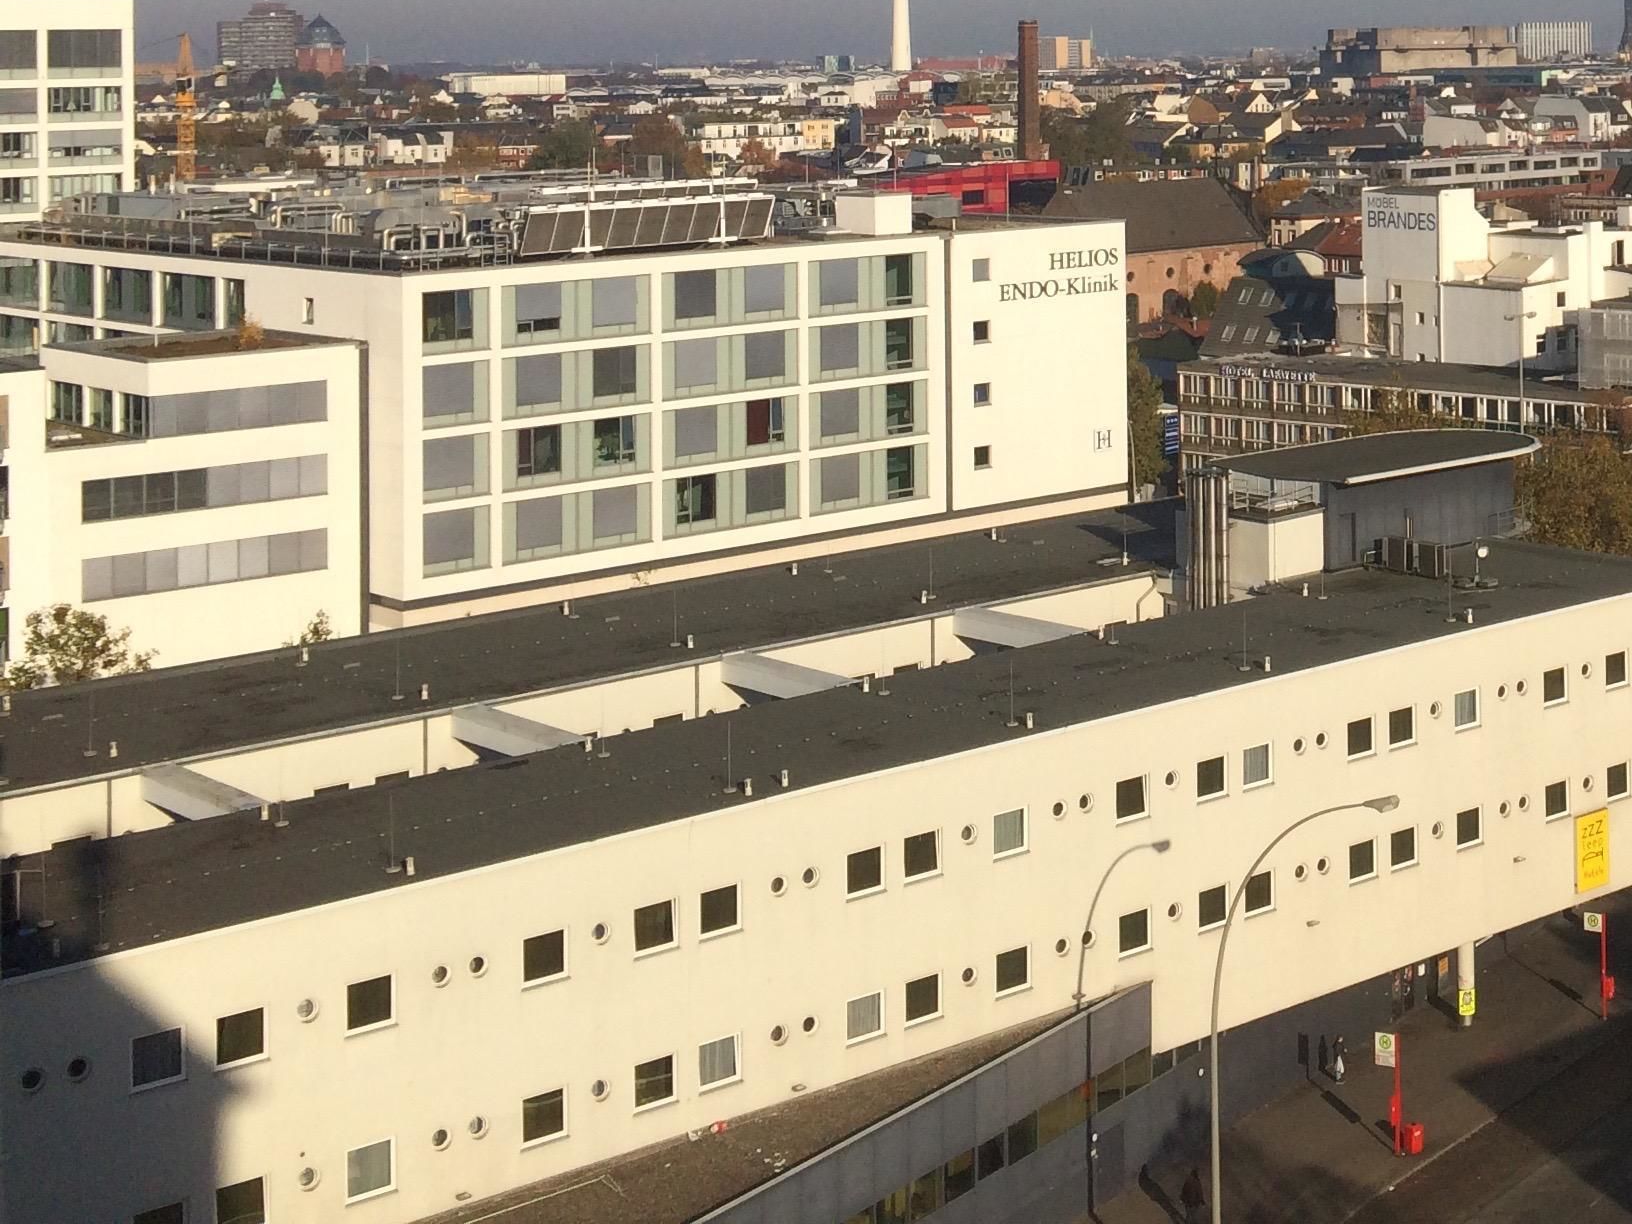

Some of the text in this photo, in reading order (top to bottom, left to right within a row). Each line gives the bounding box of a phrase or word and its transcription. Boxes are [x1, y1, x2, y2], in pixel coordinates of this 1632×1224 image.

[1367, 210, 1436, 231] BRANDES
[1049, 247, 1119, 270] HELIOS
[999, 273, 1119, 302] ENDO-Klinik
